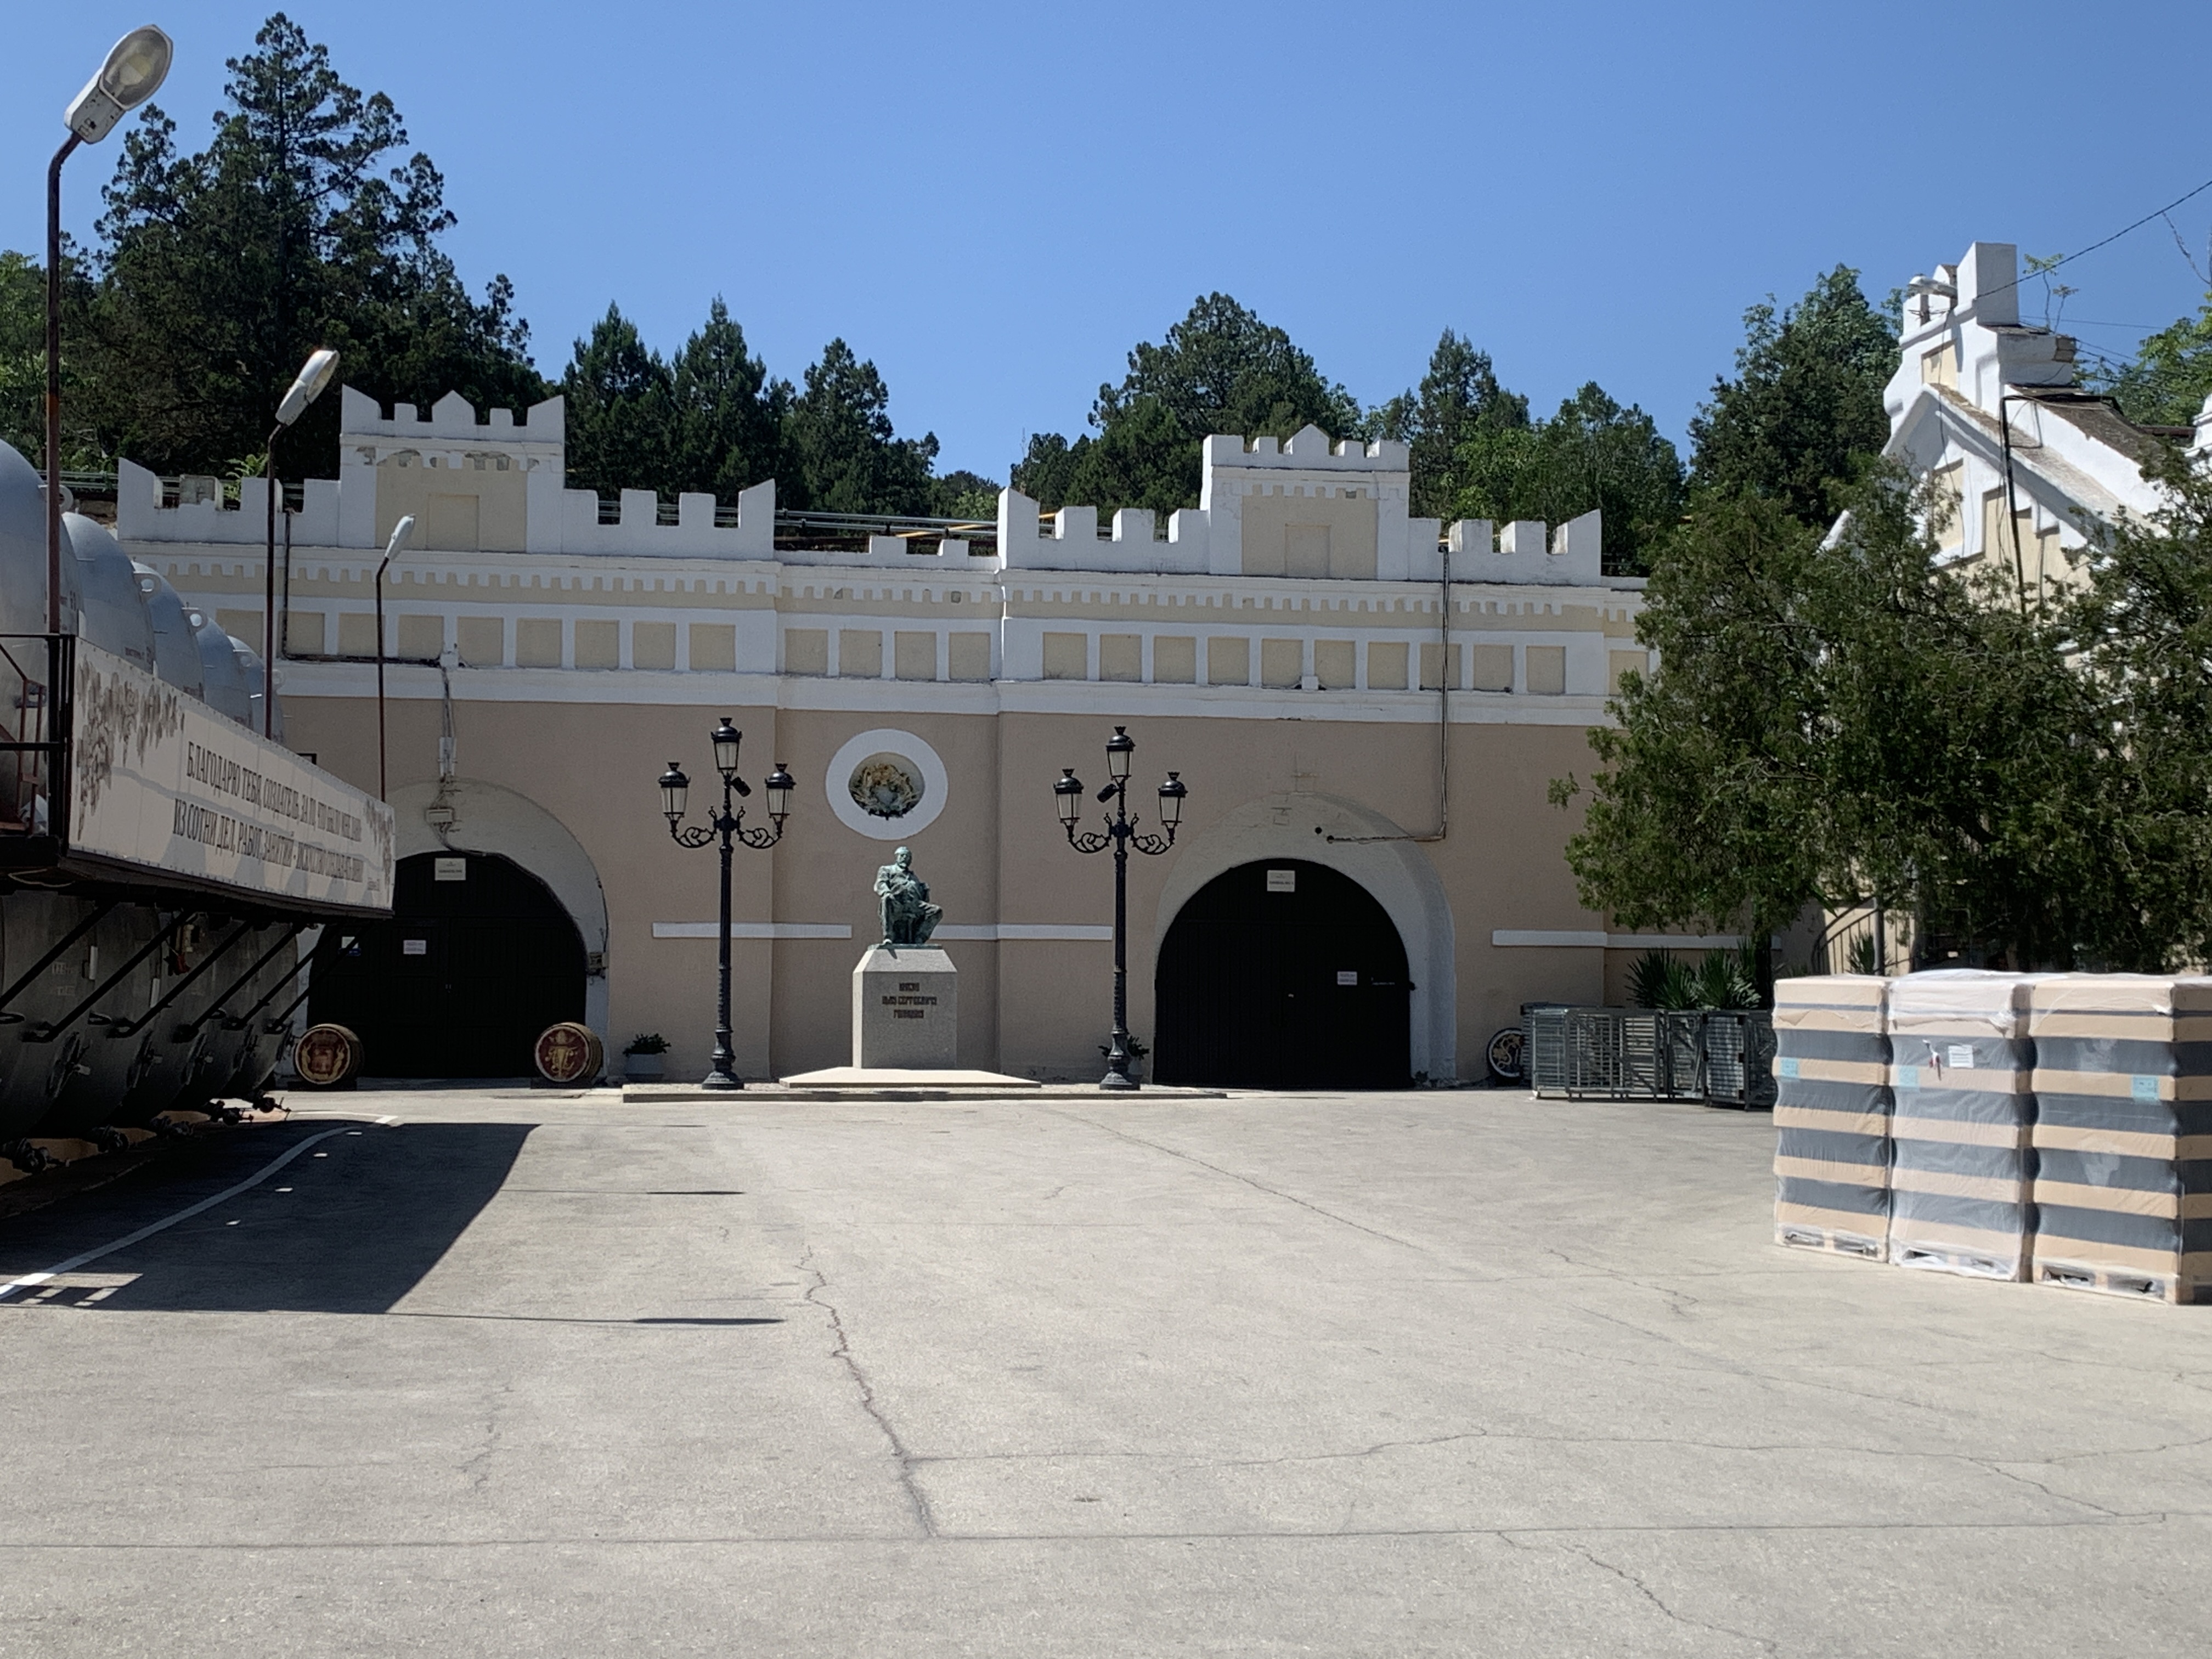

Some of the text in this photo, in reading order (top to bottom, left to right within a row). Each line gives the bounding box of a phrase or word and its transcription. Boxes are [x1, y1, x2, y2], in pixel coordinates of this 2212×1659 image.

[187, 741, 240, 798] БЛАГОДАРЮ
[173, 798, 187, 836] ИЗ
[187, 804, 218, 845] СОТНИ
